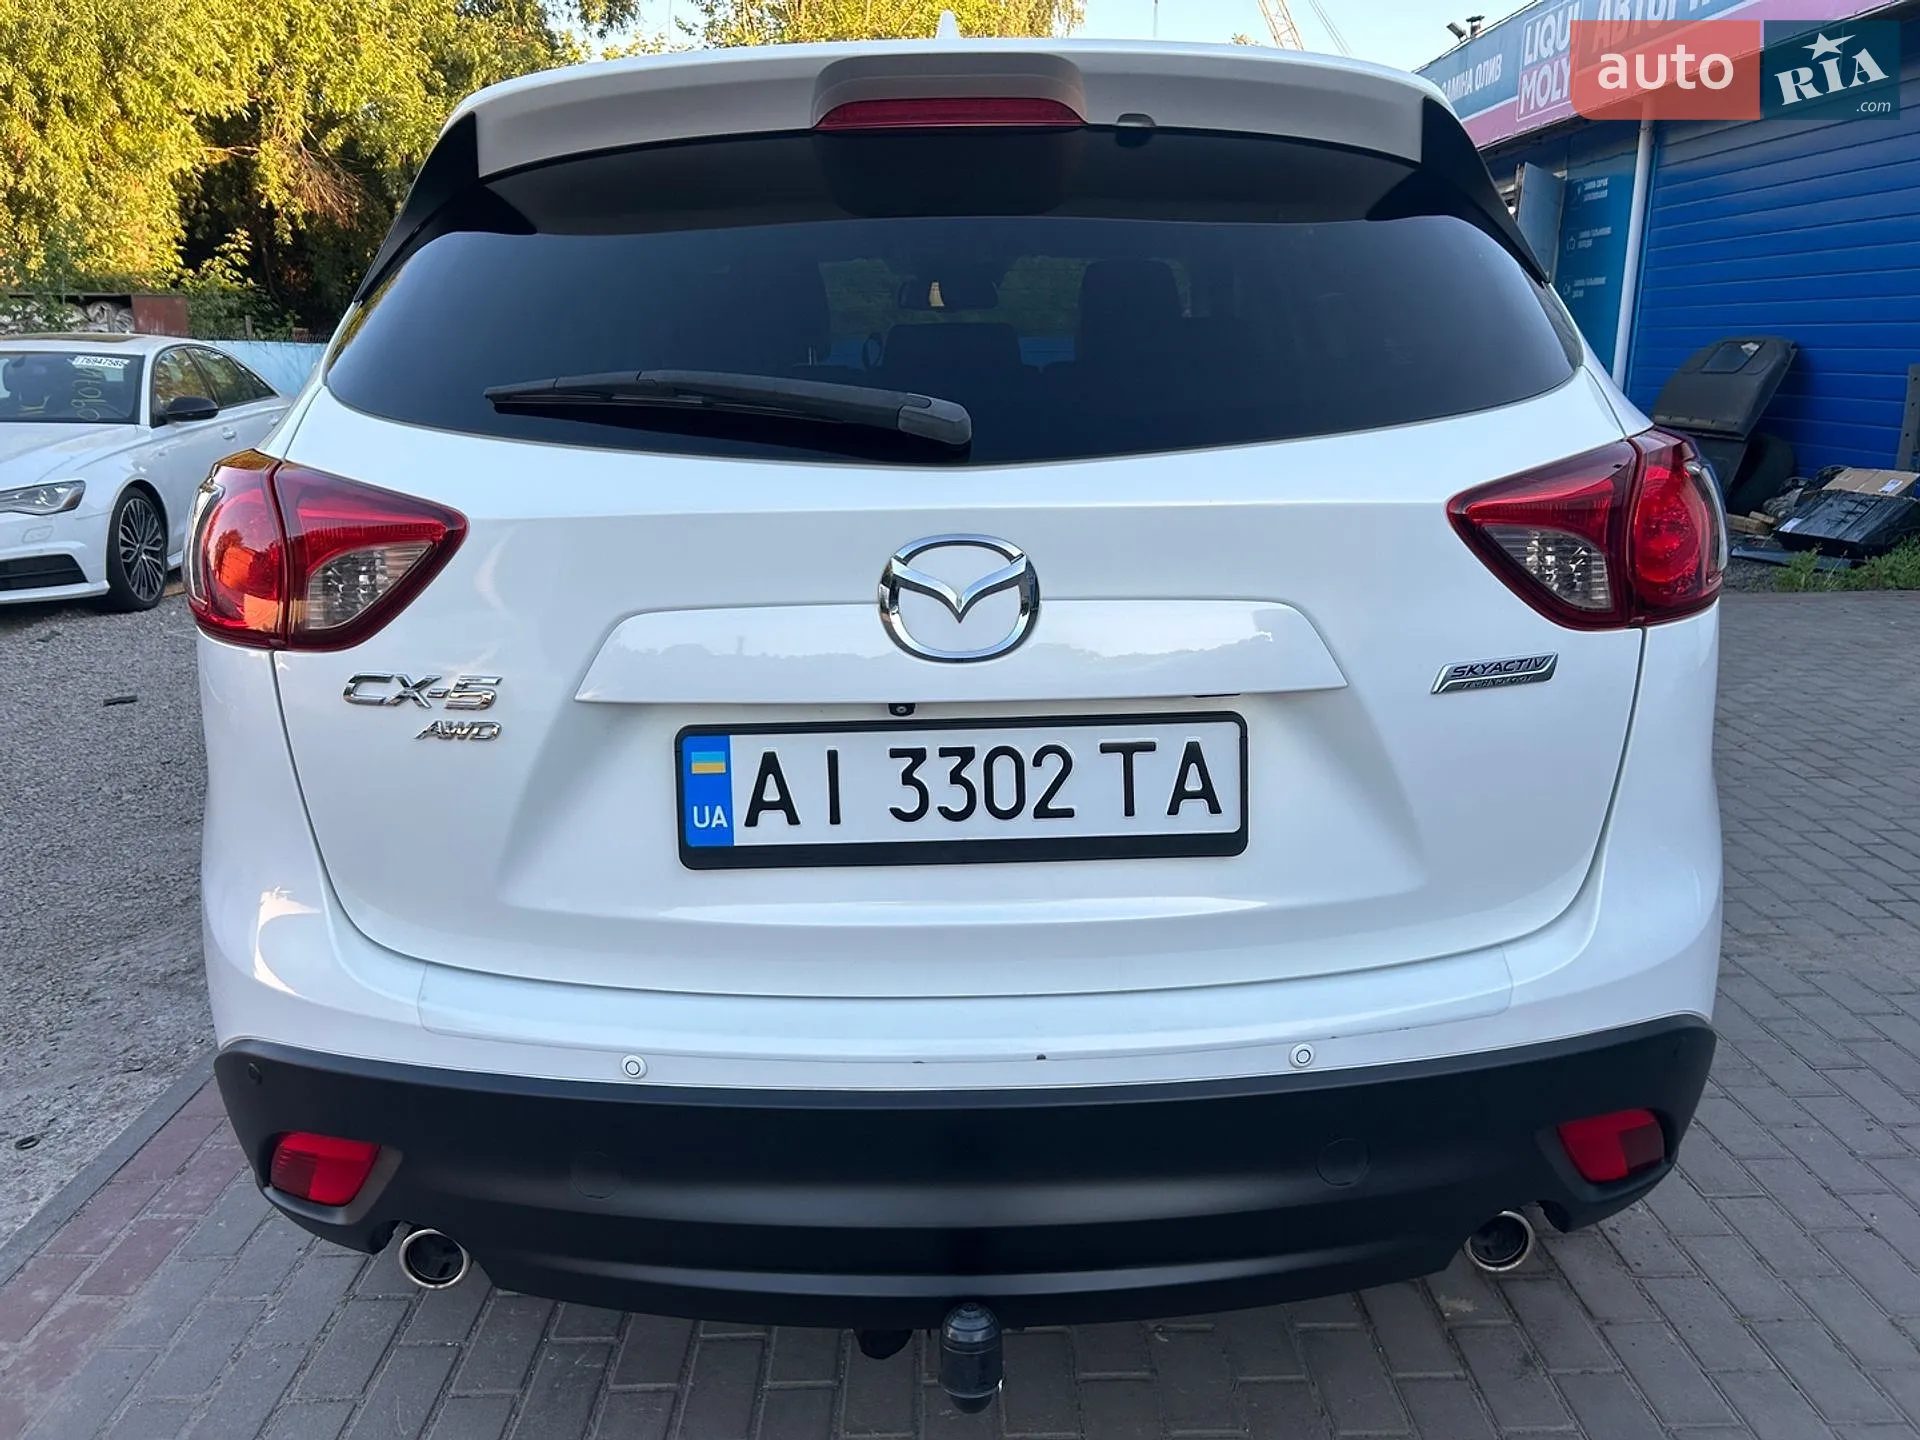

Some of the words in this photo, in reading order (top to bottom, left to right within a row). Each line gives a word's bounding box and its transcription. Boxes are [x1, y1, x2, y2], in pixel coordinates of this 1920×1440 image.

[1519, 51, 1576, 115] MOLY
[1451, 656, 1549, 679] SKYACTIV
[343, 671, 503, 711] CX-5
[415, 720, 503, 742] AWD
[744, 749, 842, 828] AI
[888, 744, 1075, 823] 3302
[1099, 740, 1222, 817] TA
[692, 805, 728, 829] UA
